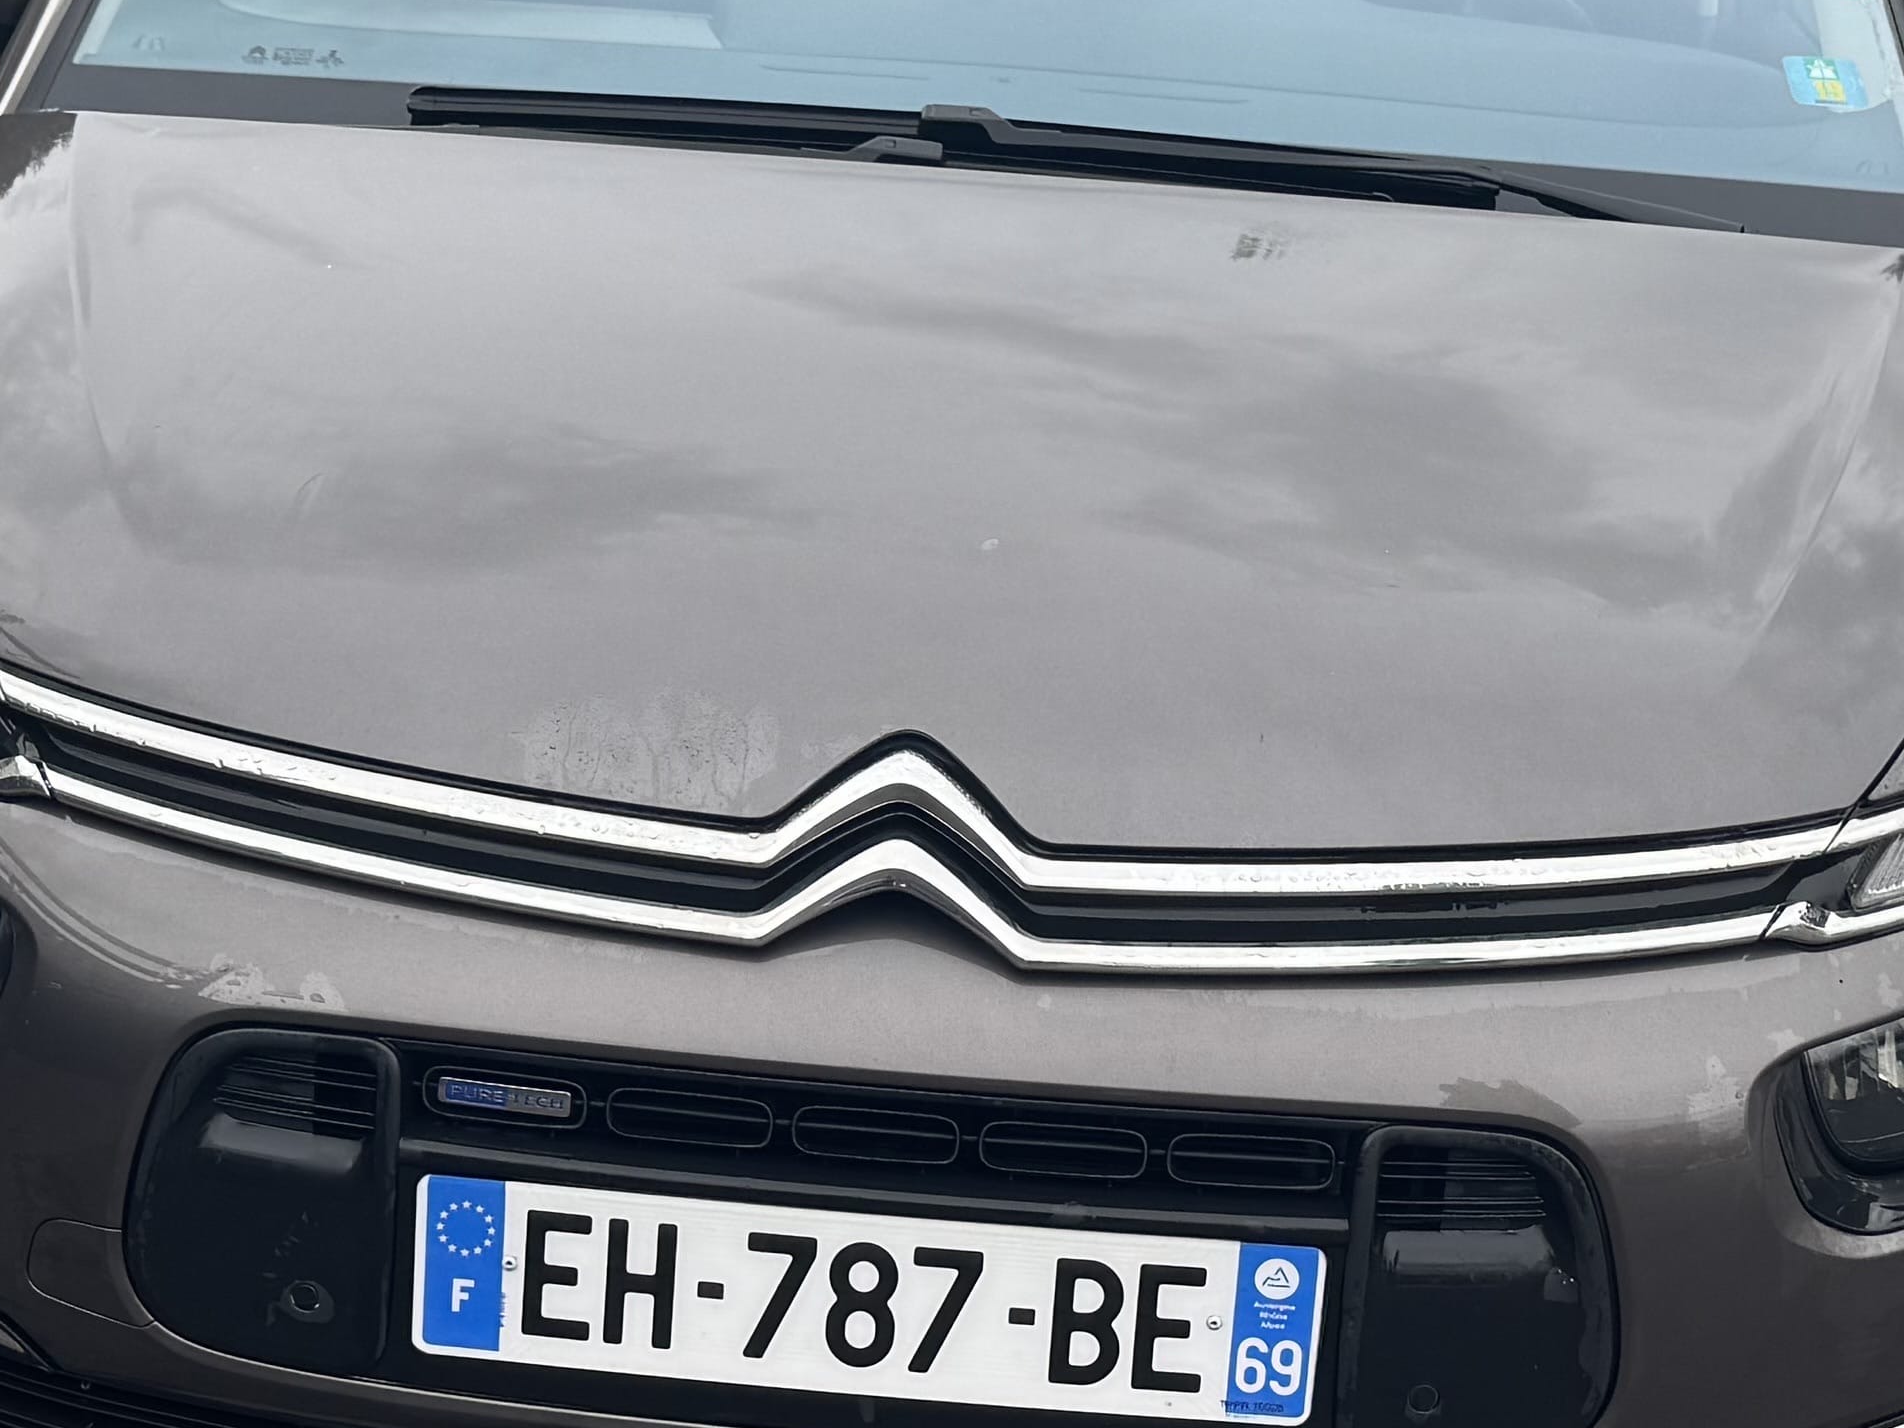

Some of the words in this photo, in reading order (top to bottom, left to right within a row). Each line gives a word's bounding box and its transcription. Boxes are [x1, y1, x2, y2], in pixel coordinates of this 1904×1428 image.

[451, 1278, 475, 1312] F
[521, 1209, 1207, 1393] EH-787-BE
[1235, 1337, 1303, 1396] 69
